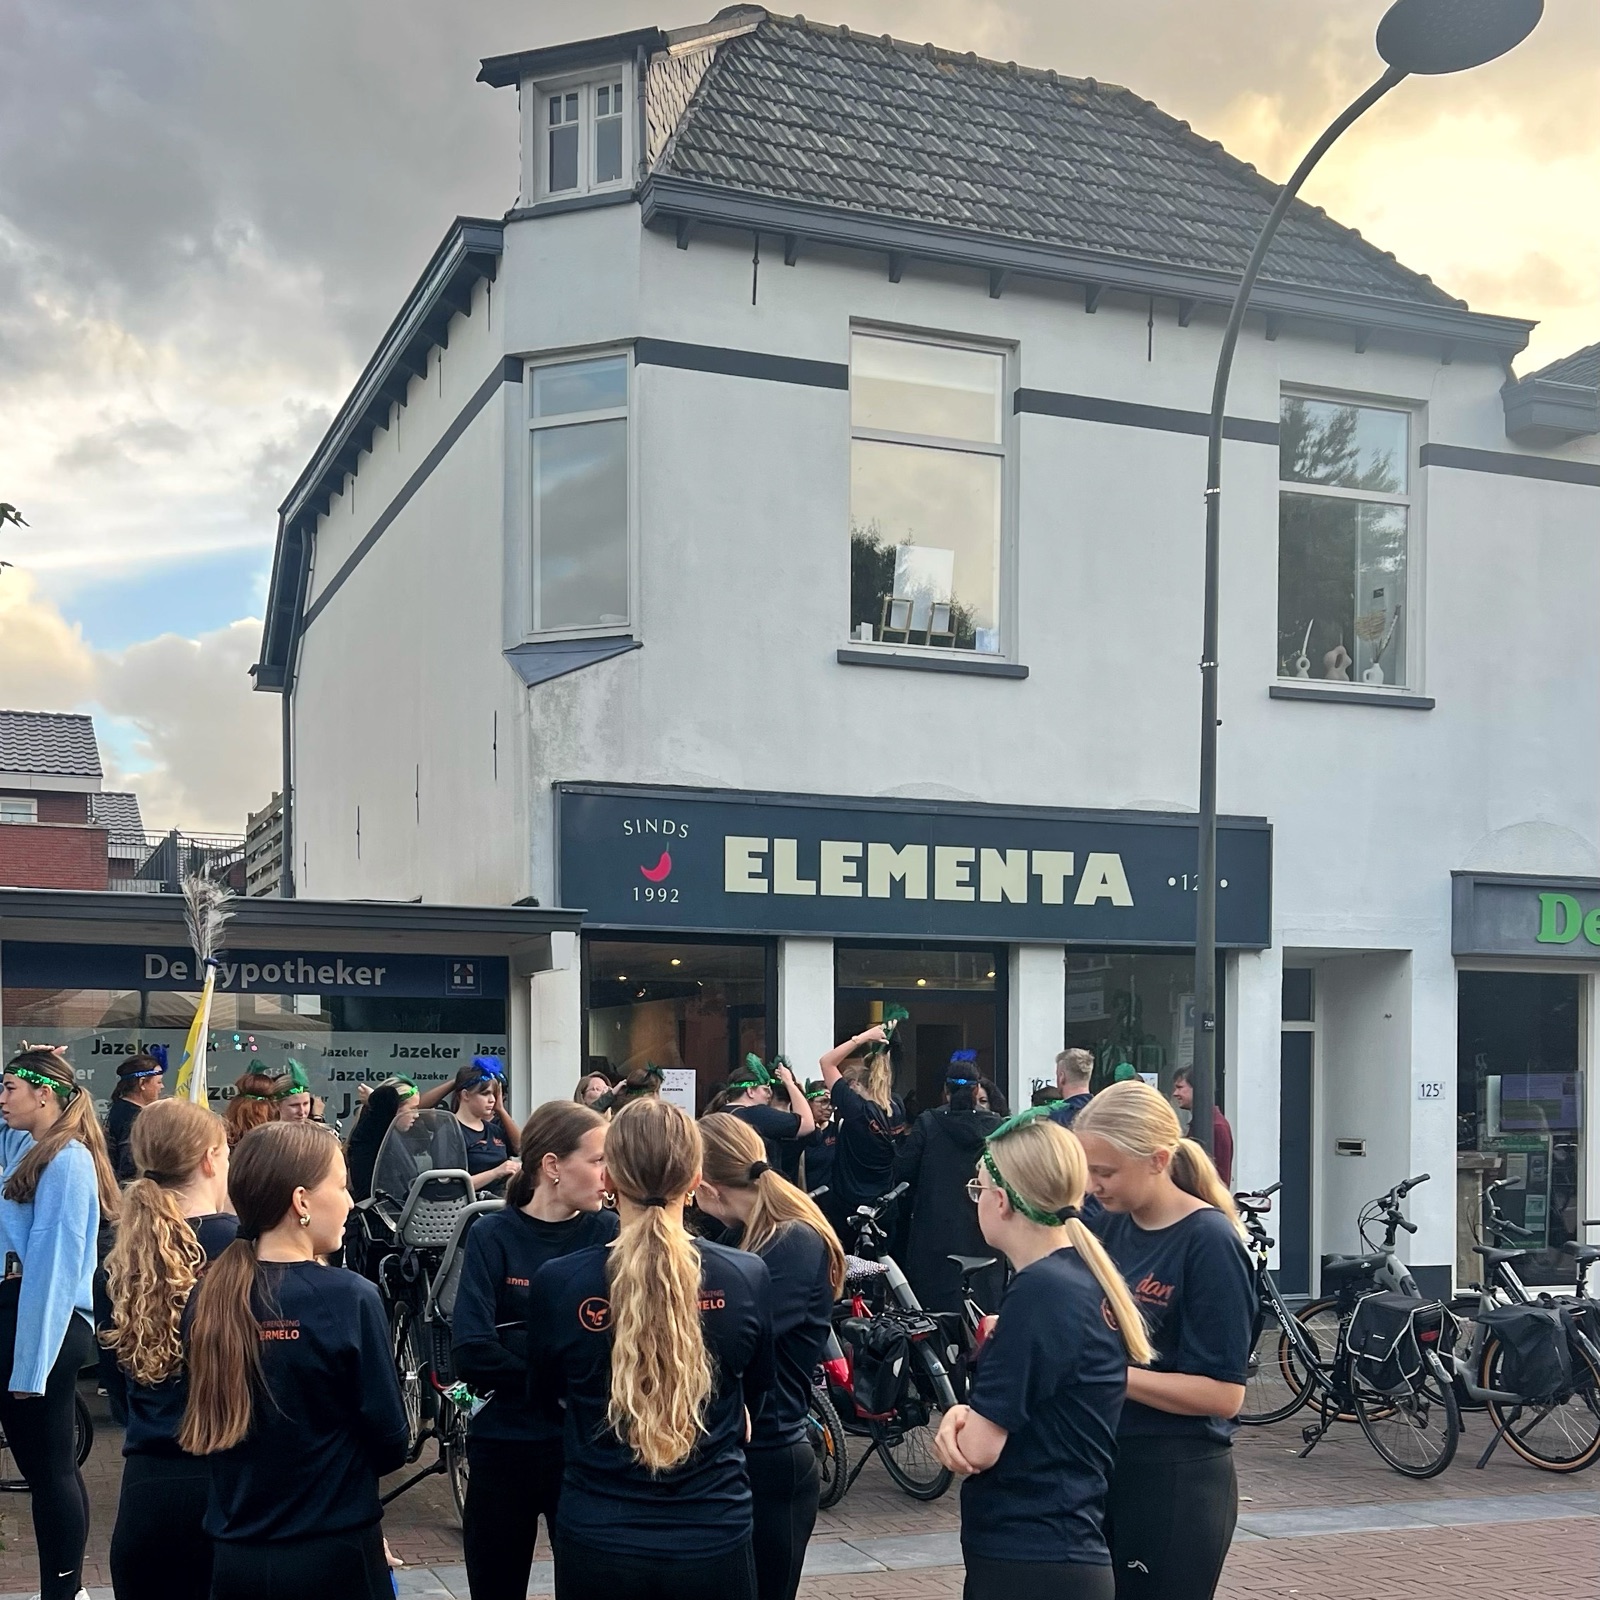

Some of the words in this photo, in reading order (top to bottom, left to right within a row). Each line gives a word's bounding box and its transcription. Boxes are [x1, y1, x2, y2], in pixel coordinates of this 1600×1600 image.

[623, 818, 689, 838] SINDS
[724, 835, 1135, 907] ELEMENTA
[633, 887, 679, 903] 1992
[145, 953, 188, 981] De
[320, 1047, 369, 1058] Jazeker
[389, 1043, 461, 1060] Jazeker
[474, 1043, 506, 1056] Jaze
[327, 1067, 393, 1082] Jazeker
[411, 1071, 449, 1081] Jazeker
